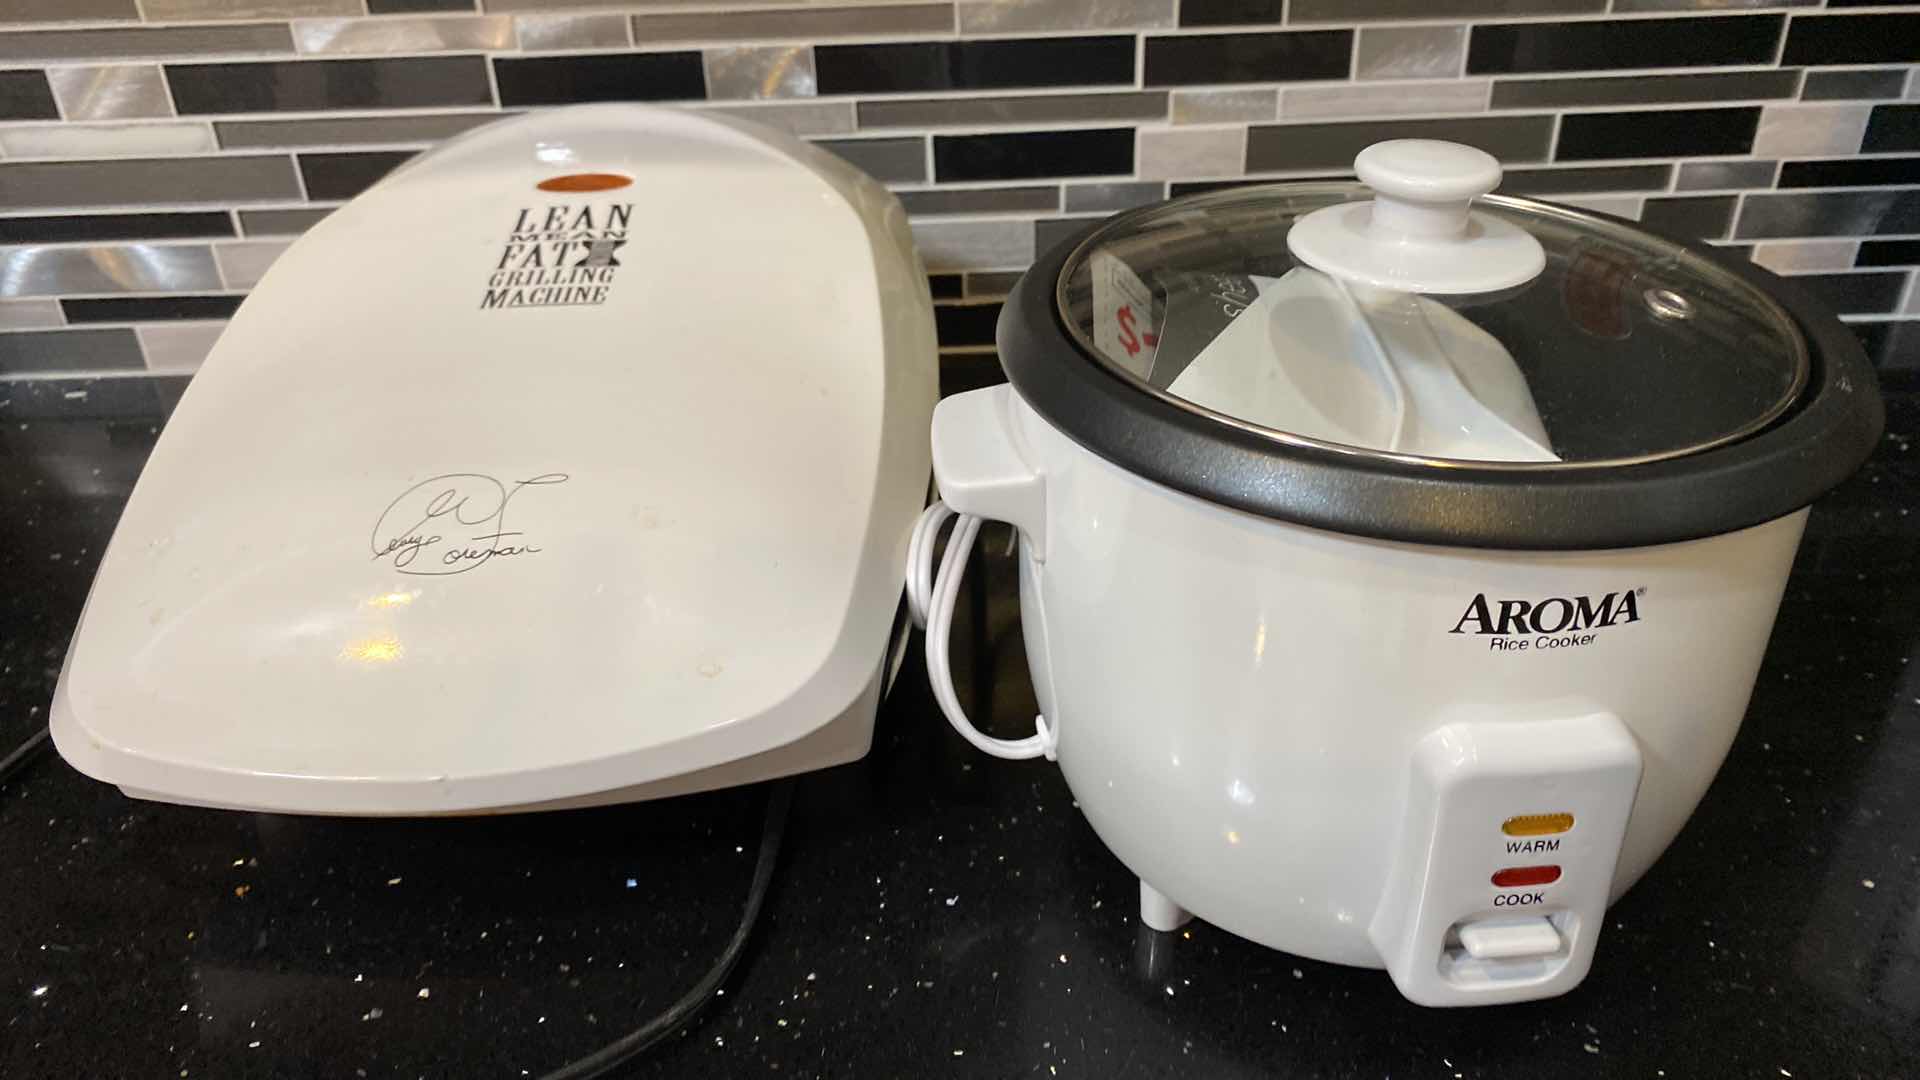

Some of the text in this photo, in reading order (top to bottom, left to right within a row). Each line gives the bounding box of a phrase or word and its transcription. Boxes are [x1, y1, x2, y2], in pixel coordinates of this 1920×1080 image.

[513, 203, 636, 233] LEAN
[510, 230, 629, 242] MEAN
[497, 242, 580, 269] FAT
[488, 268, 615, 287] GRILLING
[480, 285, 610, 309] MACHINE
[1489, 634, 1597, 651] Rice Cooker
[1506, 839, 1560, 854] WARM
[1494, 892, 1544, 907] COOK
